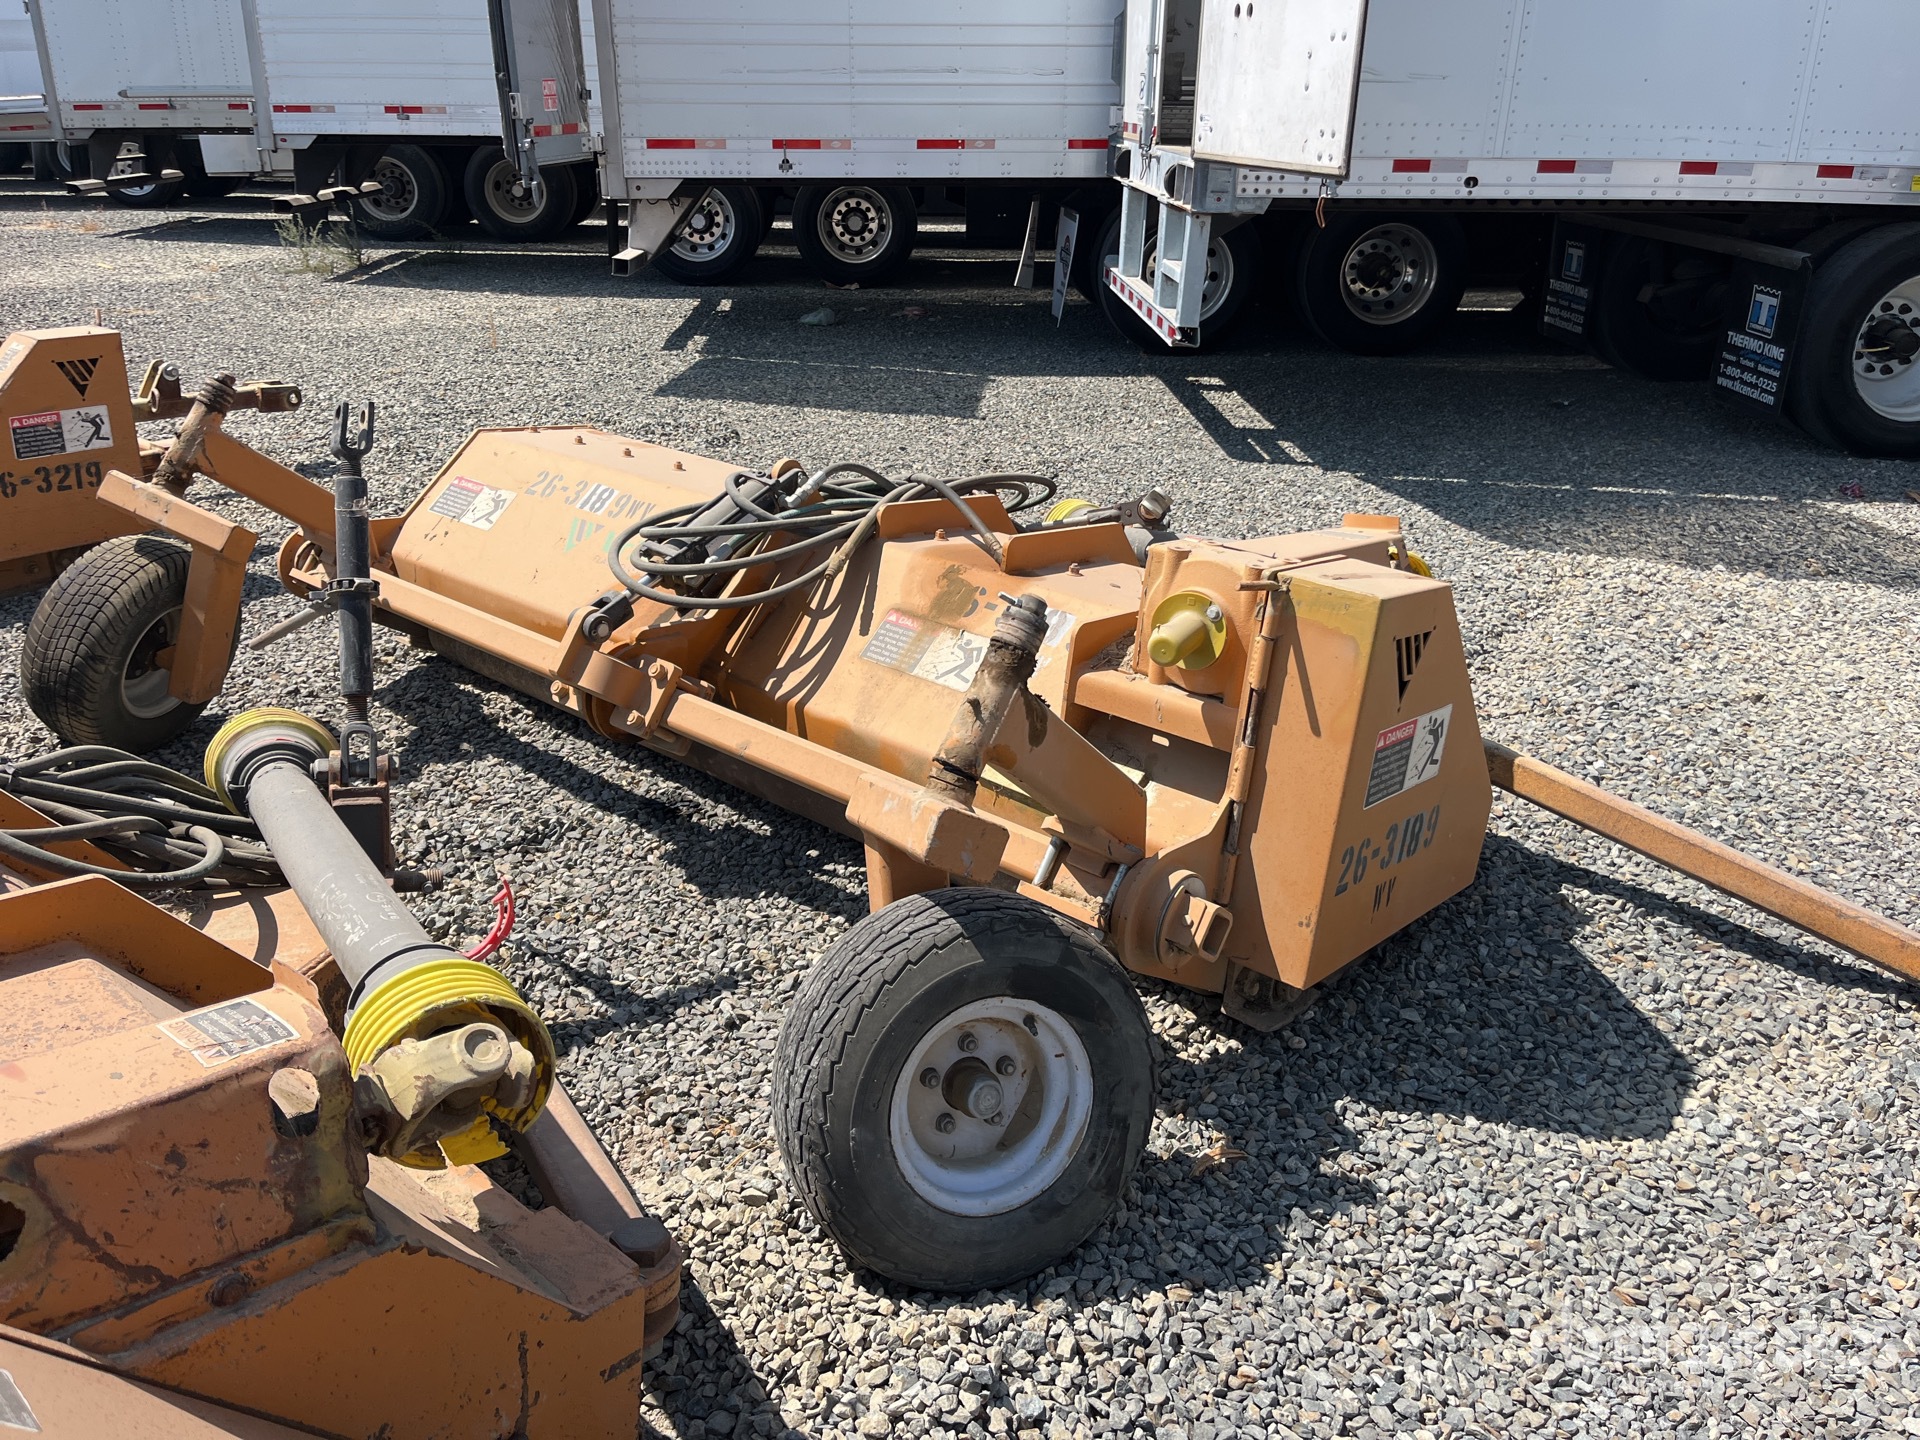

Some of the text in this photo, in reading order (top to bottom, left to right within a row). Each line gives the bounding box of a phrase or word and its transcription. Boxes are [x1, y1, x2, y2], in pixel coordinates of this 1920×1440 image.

[1550, 279, 1588, 299] THERMO KING
[1727, 331, 1763, 353] THERMO
[1763, 343, 1785, 361] KING
[1722, 352, 1737, 362] Fresno
[1740, 357, 1755, 369] Turlock
[1758, 364, 1780, 378] Bakersfield
[1719, 364, 1777, 392] 1-800-464-0225
[1717, 376, 1774, 406] www.tkcencal.com
[22, 415, 58, 426] DANGER
[459, 480, 483, 492] DANGER
[886, 624, 902, 634] Rotating
[884, 637, 897, 645] throw
[886, 645, 899, 653] Keep
[867, 652, 885, 662] stopped
[1385, 723, 1415, 745] DANGER
[1334, 804, 1440, 897] 26-3189
